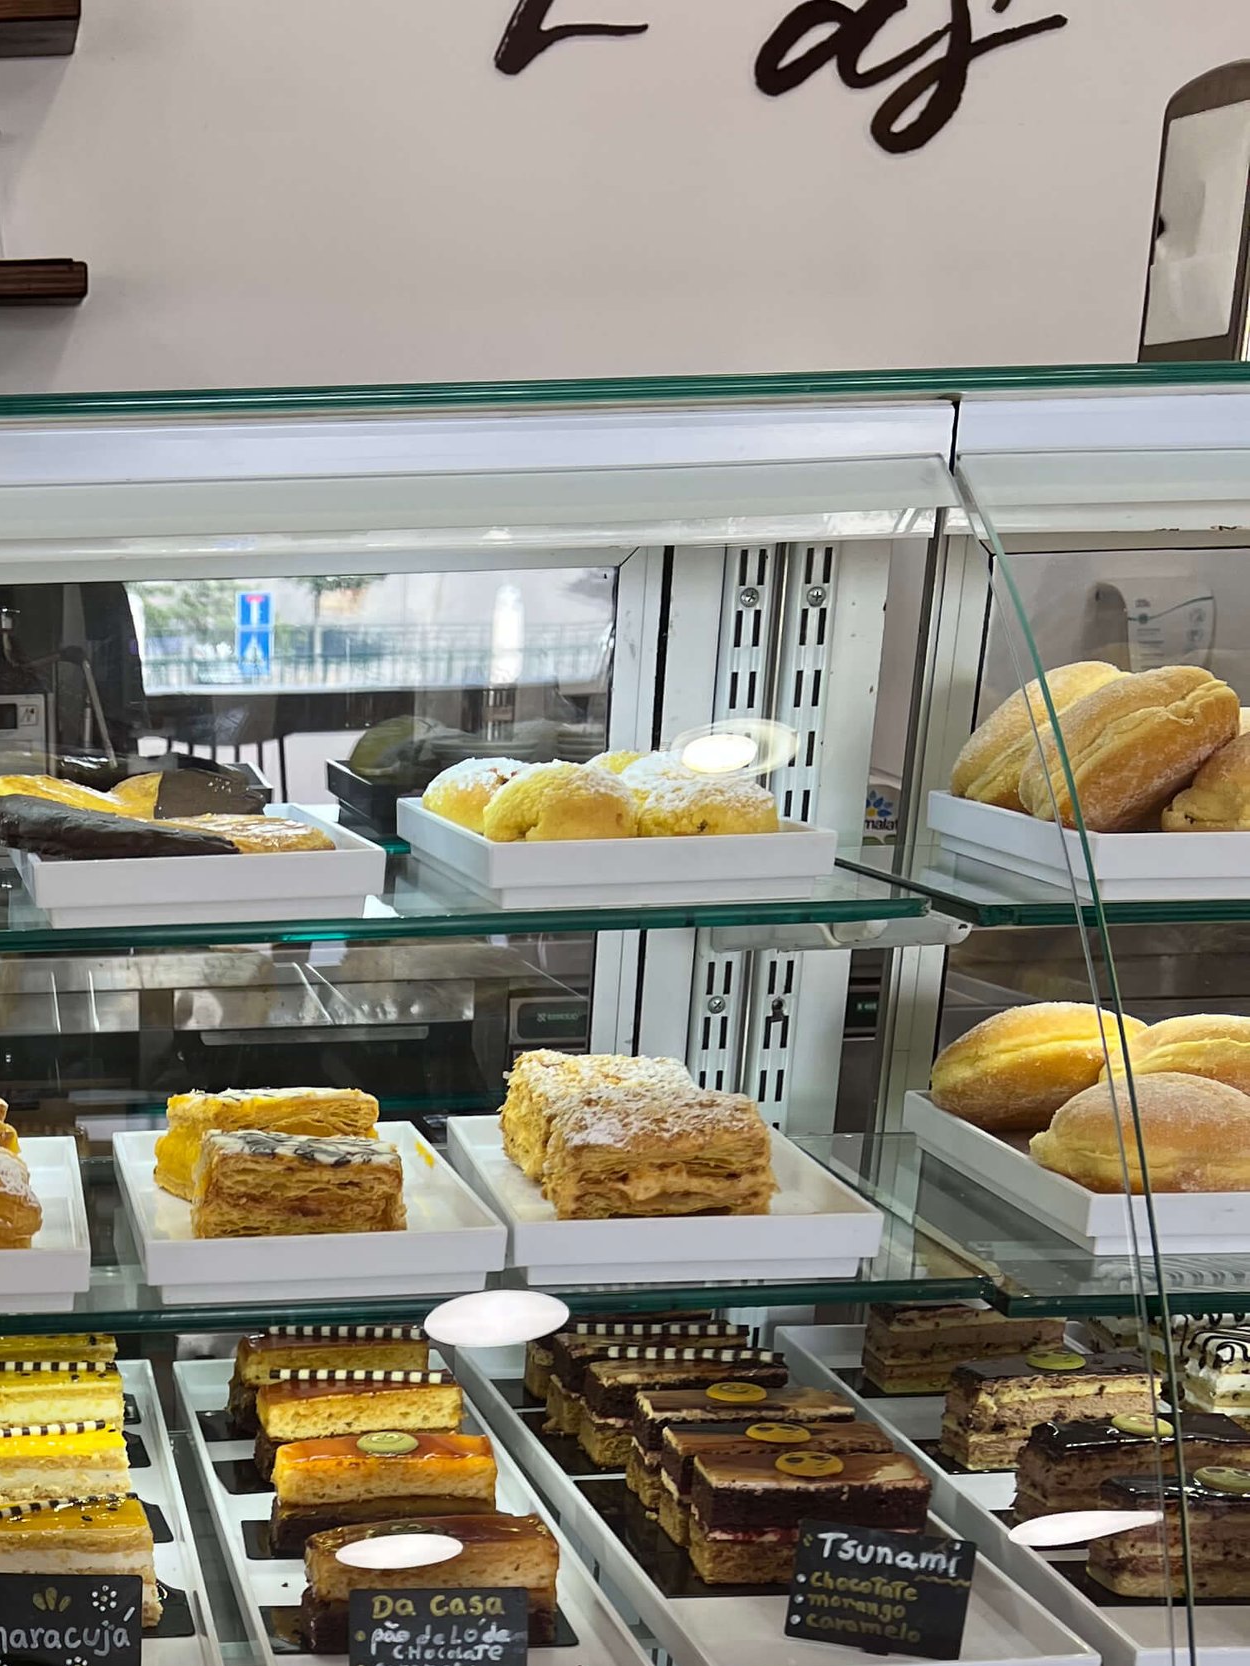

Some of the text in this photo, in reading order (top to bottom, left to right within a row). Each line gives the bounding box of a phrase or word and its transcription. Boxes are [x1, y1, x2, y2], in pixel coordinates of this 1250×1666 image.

[817, 1532, 962, 1577] Tsunami
[371, 1595, 506, 1619] Da Casa
[416, 1624, 445, 1646] de
